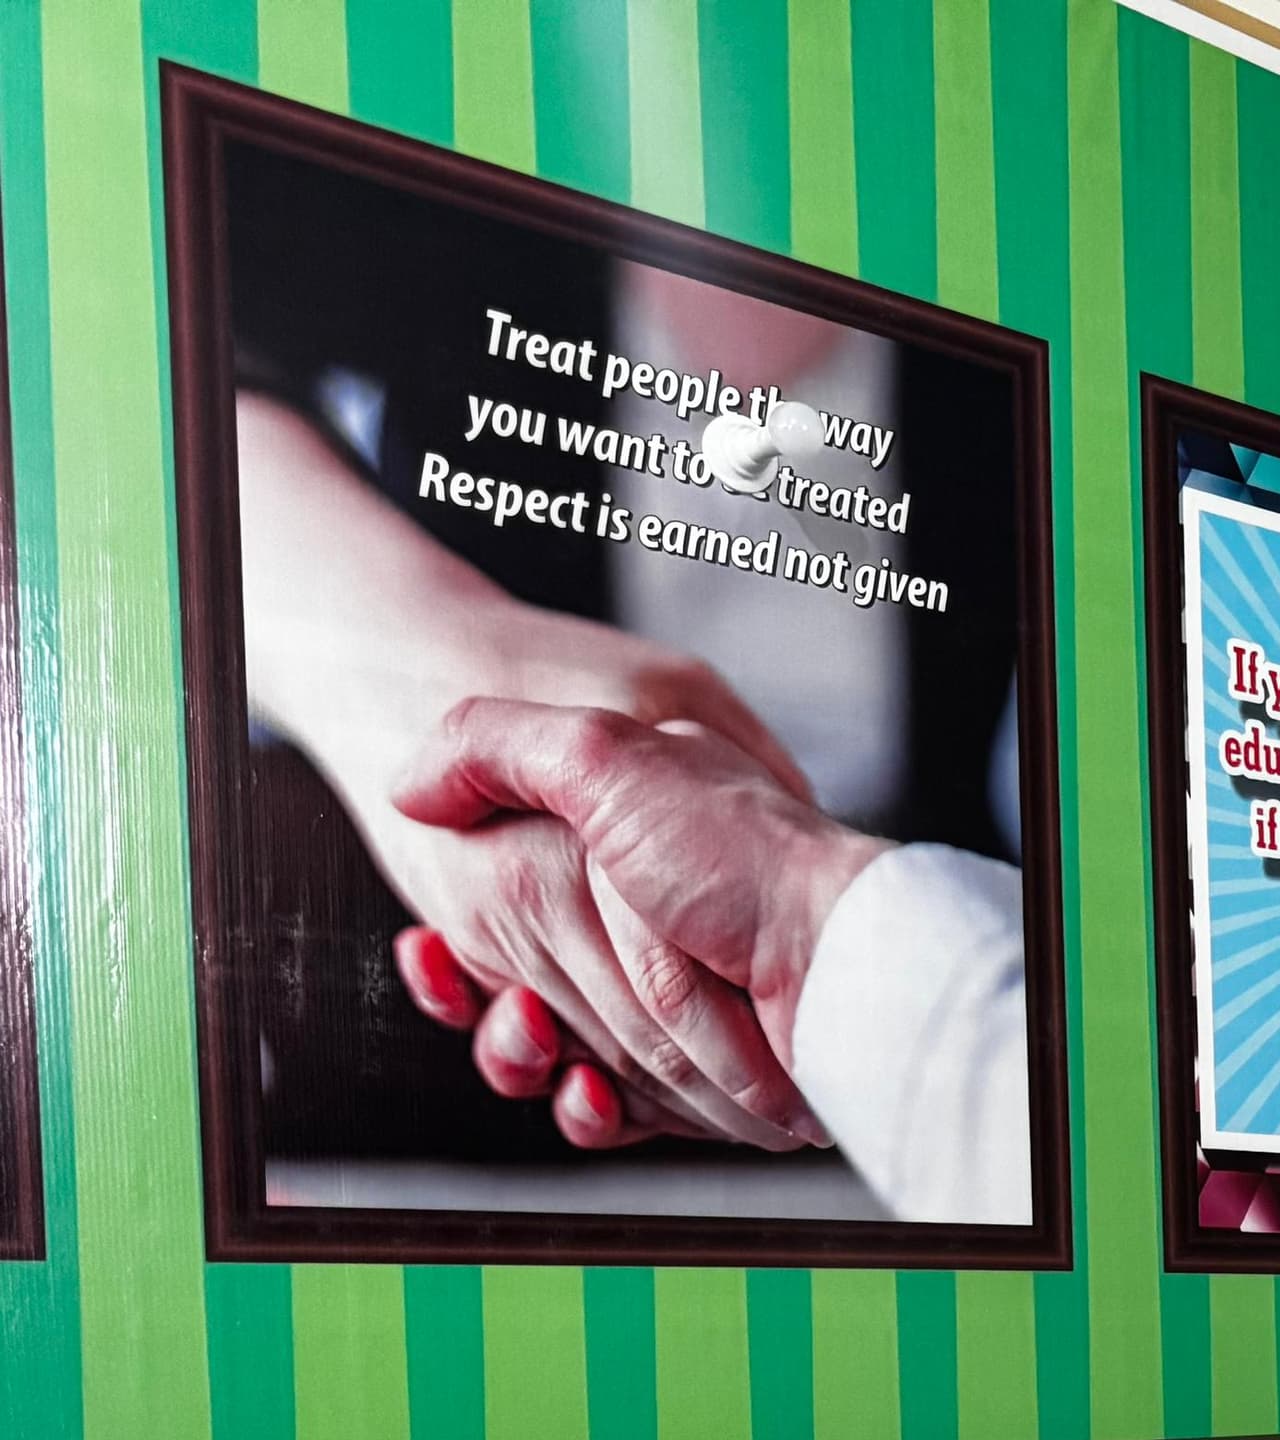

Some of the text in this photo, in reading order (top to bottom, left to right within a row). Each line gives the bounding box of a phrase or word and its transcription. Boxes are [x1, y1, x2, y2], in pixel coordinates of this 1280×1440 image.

[486, 309, 597, 383] Treat
[603, 354, 740, 419] people
[821, 411, 893, 468] way
[419, 453, 949, 613] Respect is earned not given
[465, 395, 545, 446] you
[558, 417, 665, 475] want
[673, 446, 711, 487] to
[778, 466, 911, 534] treated
[1233, 646, 1259, 695] If
[1256, 807, 1277, 851] if
